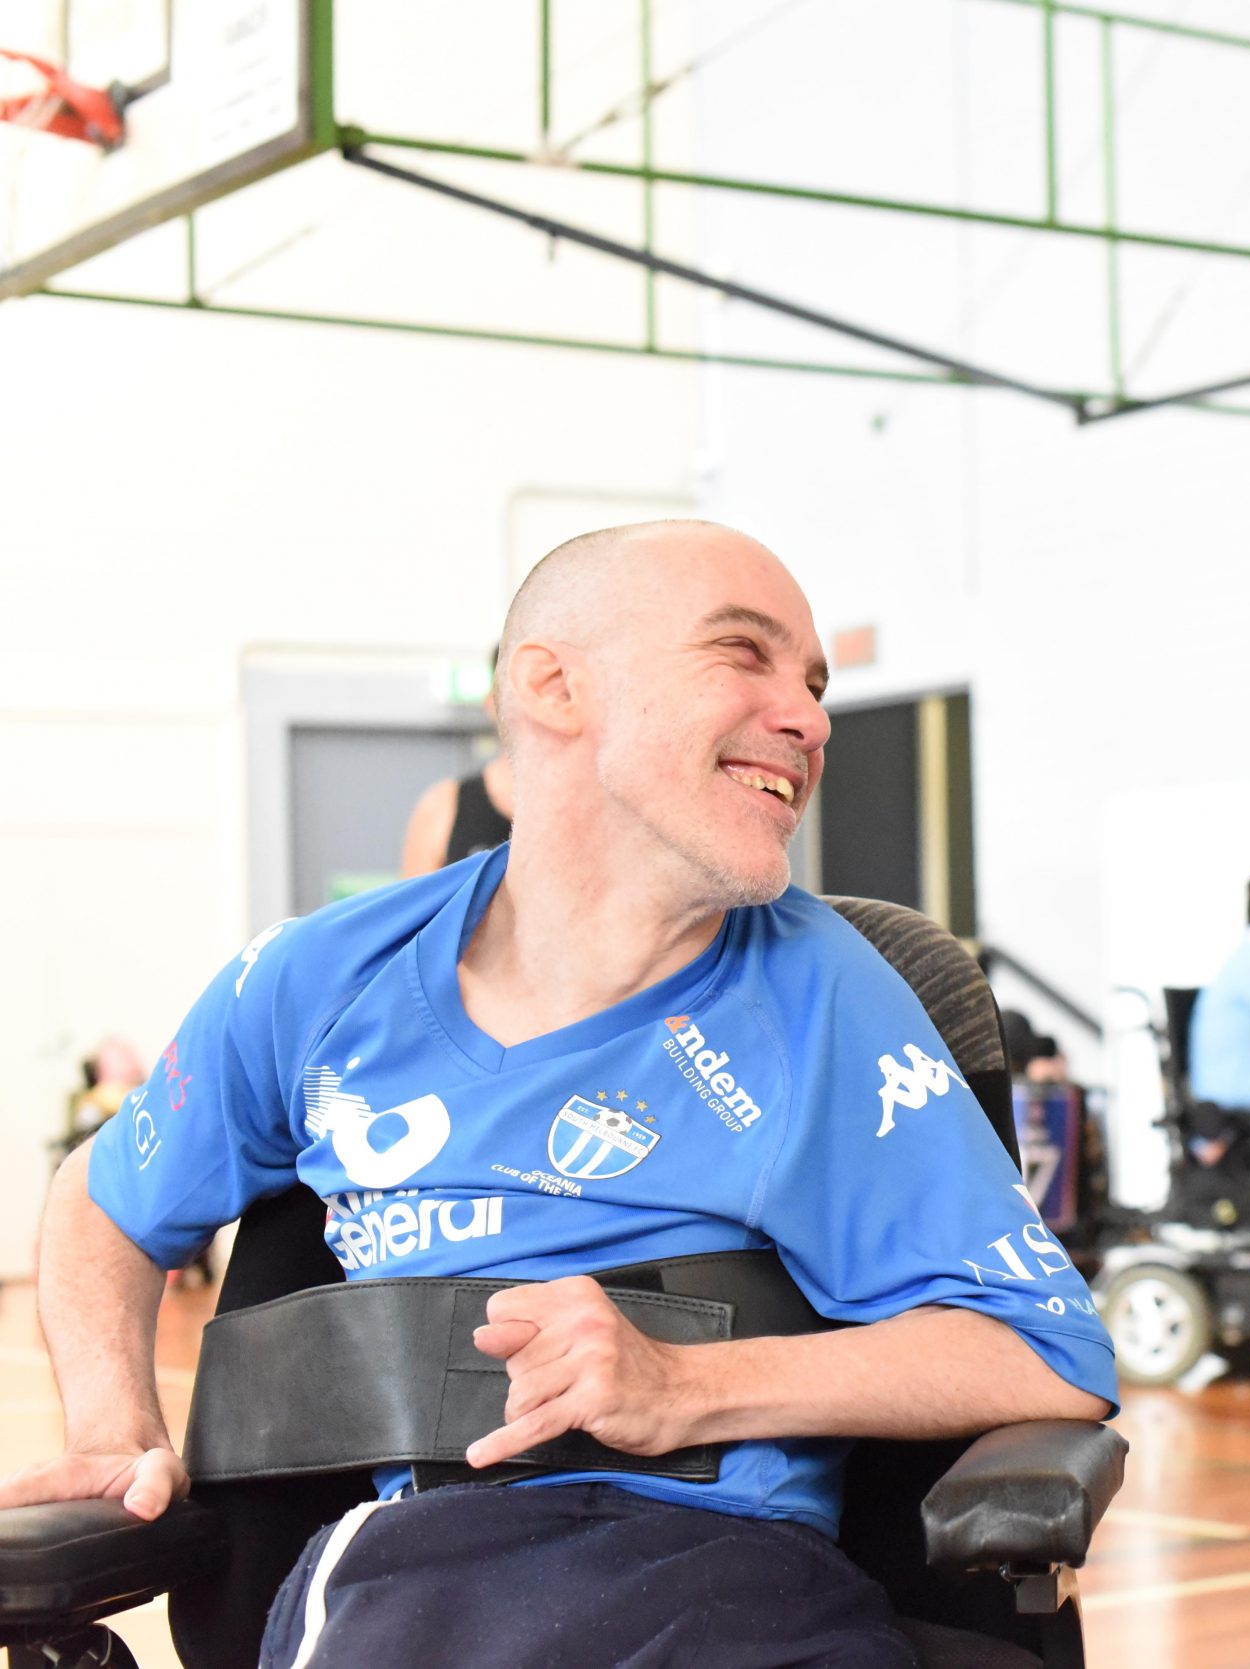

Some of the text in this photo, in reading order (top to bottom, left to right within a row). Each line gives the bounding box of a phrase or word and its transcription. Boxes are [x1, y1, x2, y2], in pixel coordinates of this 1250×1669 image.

[662, 1038, 743, 1133] BUILDING GROUP
[562, 1109, 589, 1128] SOUTH
[587, 1121, 633, 1152] MELBOURNE
[490, 1164, 520, 1177] CLUB
[520, 1173, 539, 1185] OF
[531, 1170, 582, 1197] OCEANIA
